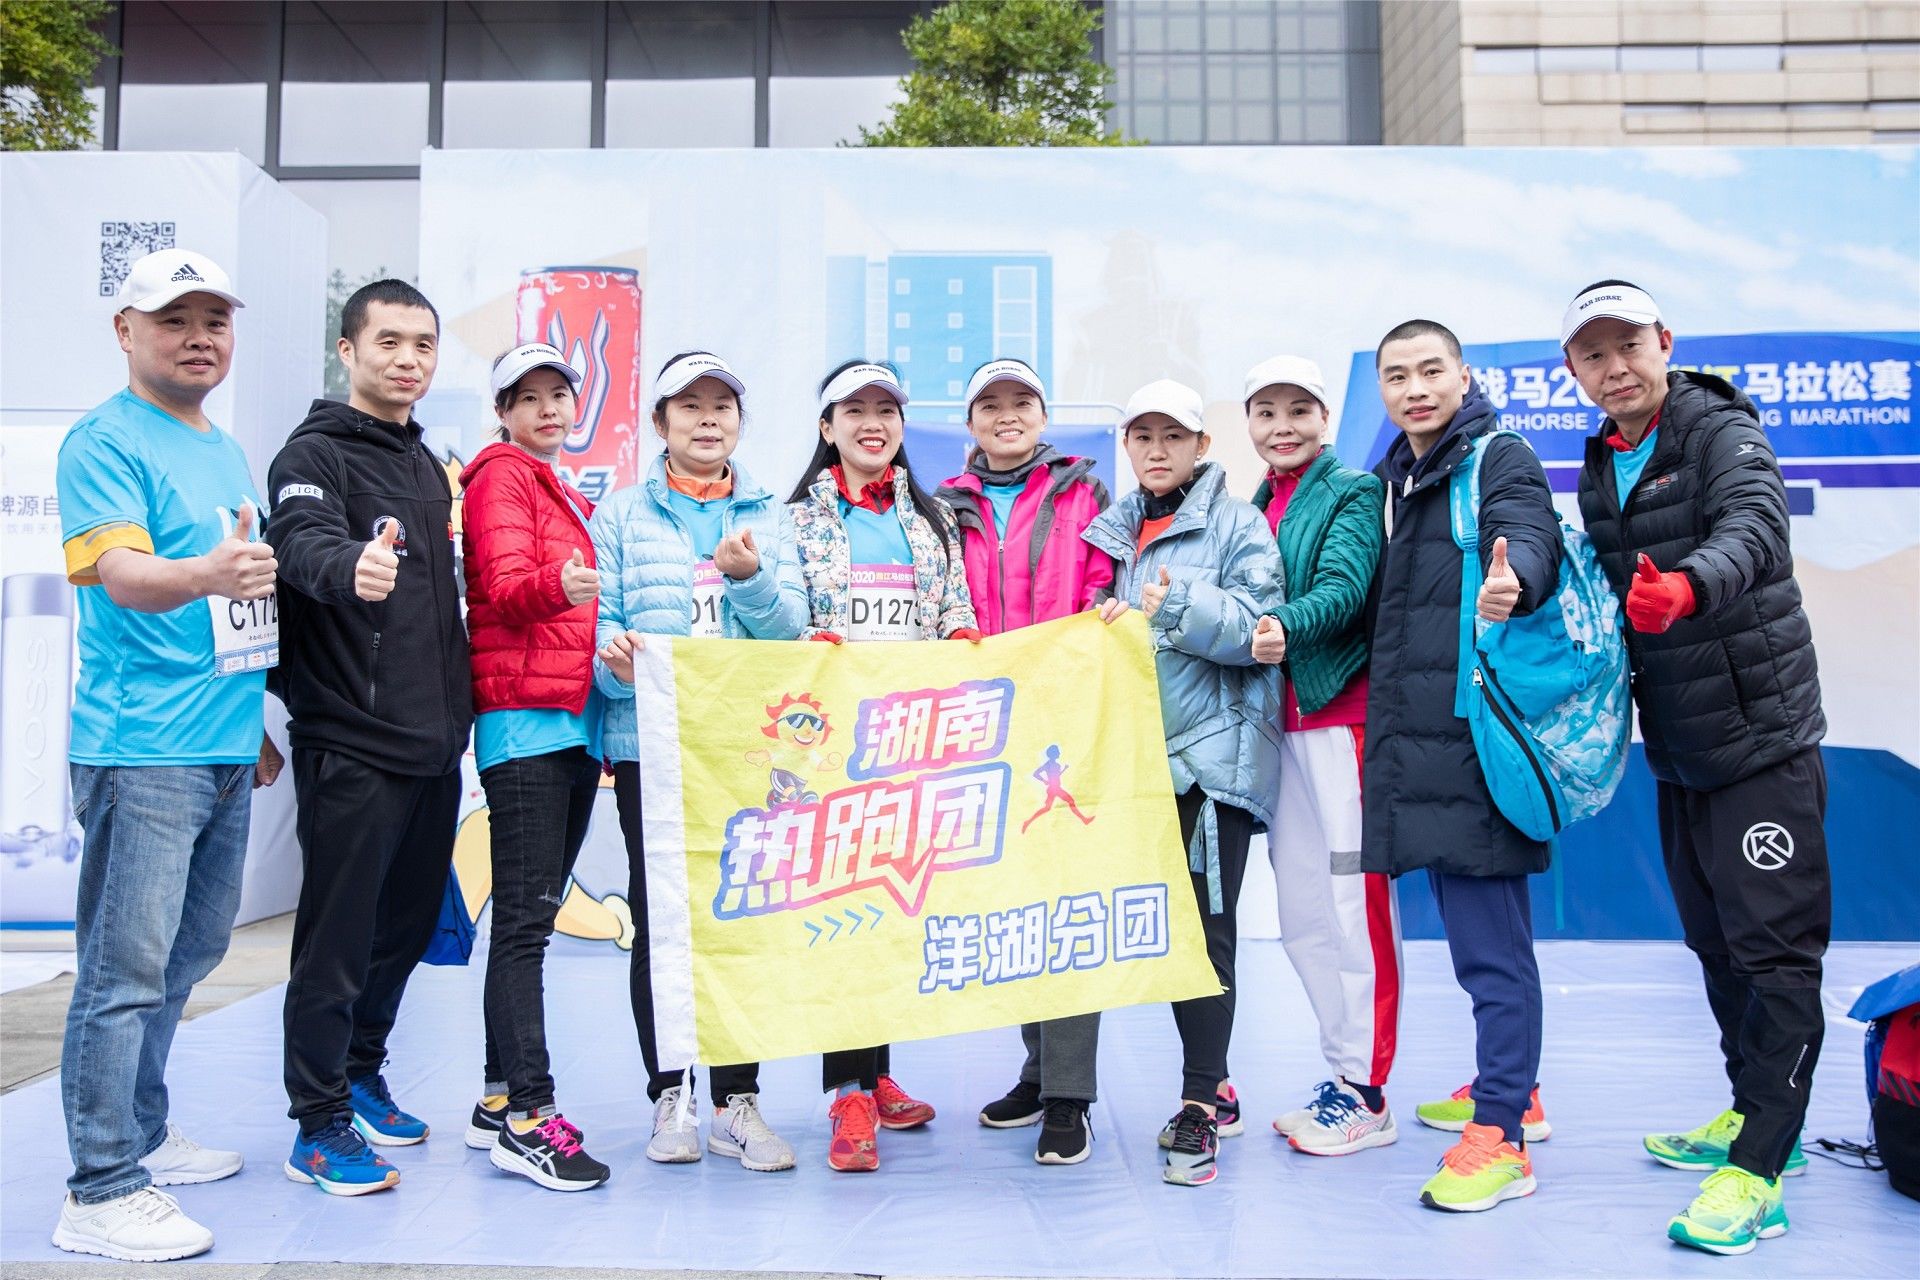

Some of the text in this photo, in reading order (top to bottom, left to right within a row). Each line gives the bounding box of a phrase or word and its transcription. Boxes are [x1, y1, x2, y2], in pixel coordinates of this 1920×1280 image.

[171, 274, 205, 283] adidas
[1579, 295, 1622, 310] WAR HORSE
[1496, 412, 1589, 432] RHORSE
[1790, 406, 1911, 426] MARATHON
[280, 486, 321, 499] OLICE
[25, 637, 49, 800] VOSS
[855, 684, 1006, 775] 湖南
[718, 770, 1003, 914] 热跑团
[919, 882, 1170, 994] 洋湖分团
